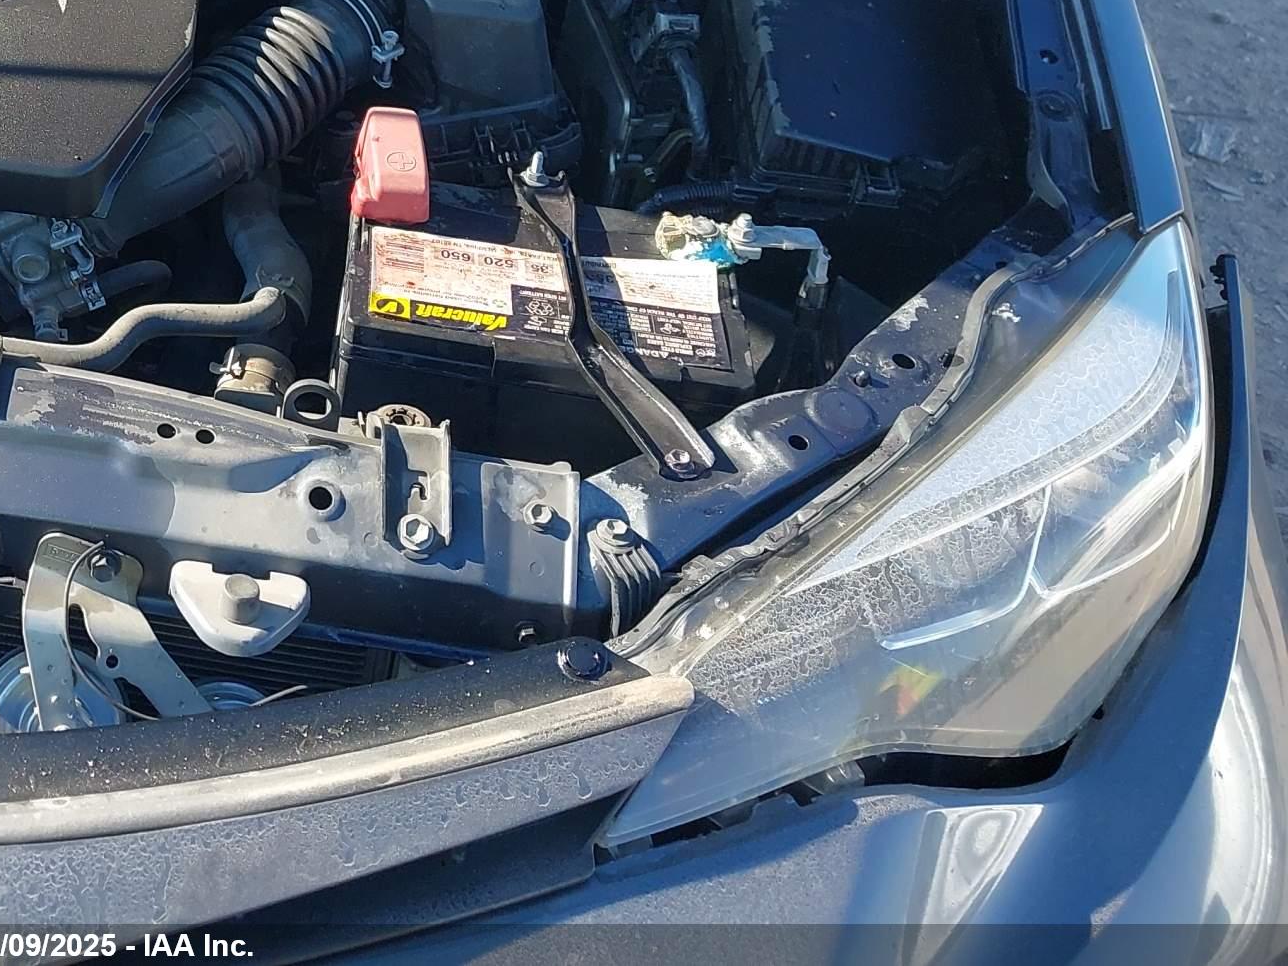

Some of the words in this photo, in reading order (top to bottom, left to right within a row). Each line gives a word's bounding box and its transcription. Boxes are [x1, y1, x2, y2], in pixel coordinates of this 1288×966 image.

[440, 249, 471, 262] 650
[483, 256, 514, 268] 520
[531, 264, 549, 274] 35
